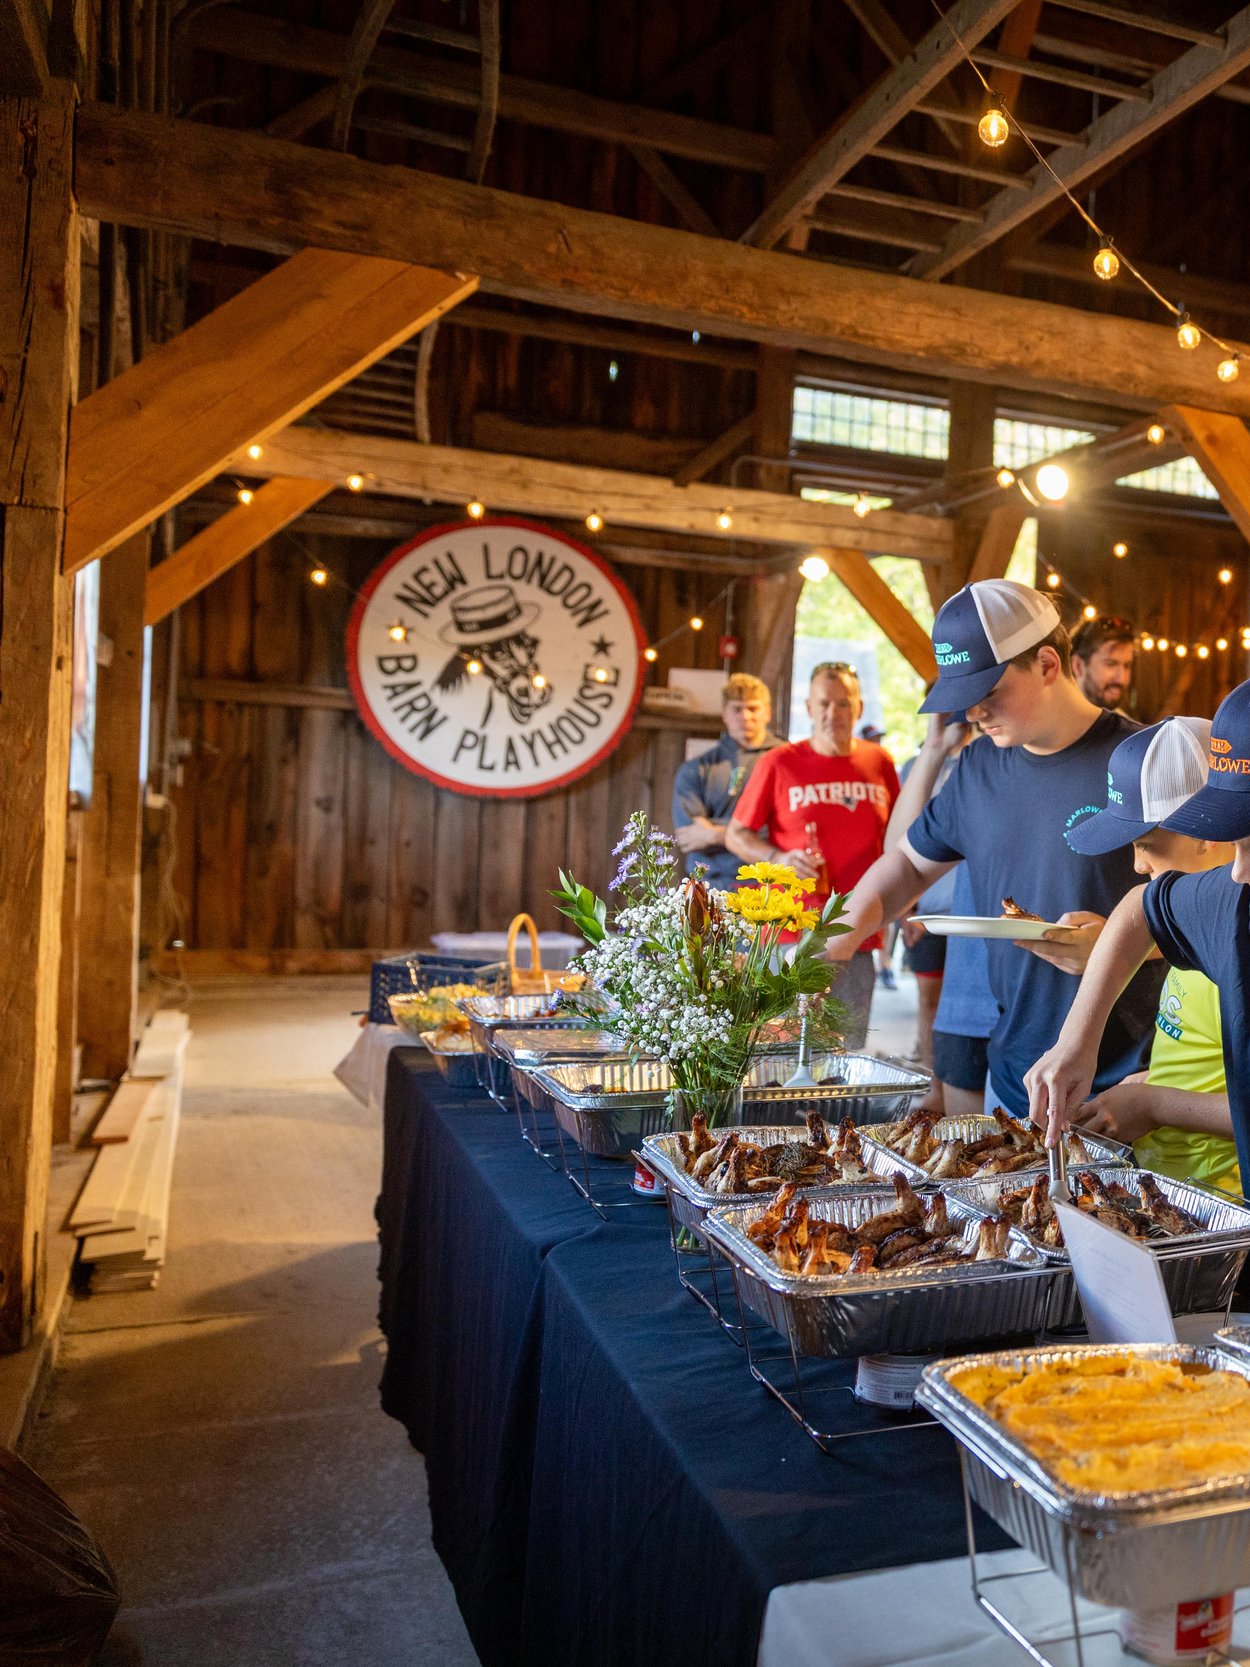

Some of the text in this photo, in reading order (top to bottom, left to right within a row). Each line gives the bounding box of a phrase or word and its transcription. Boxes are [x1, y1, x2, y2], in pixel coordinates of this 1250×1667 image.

[394, 542, 609, 628] NEW LONDON
[376, 653, 620, 771] BARN PLAYHOUSE
[788, 781, 886, 812] PATRIOTS
[1065, 805, 1103, 828] MARLOW
